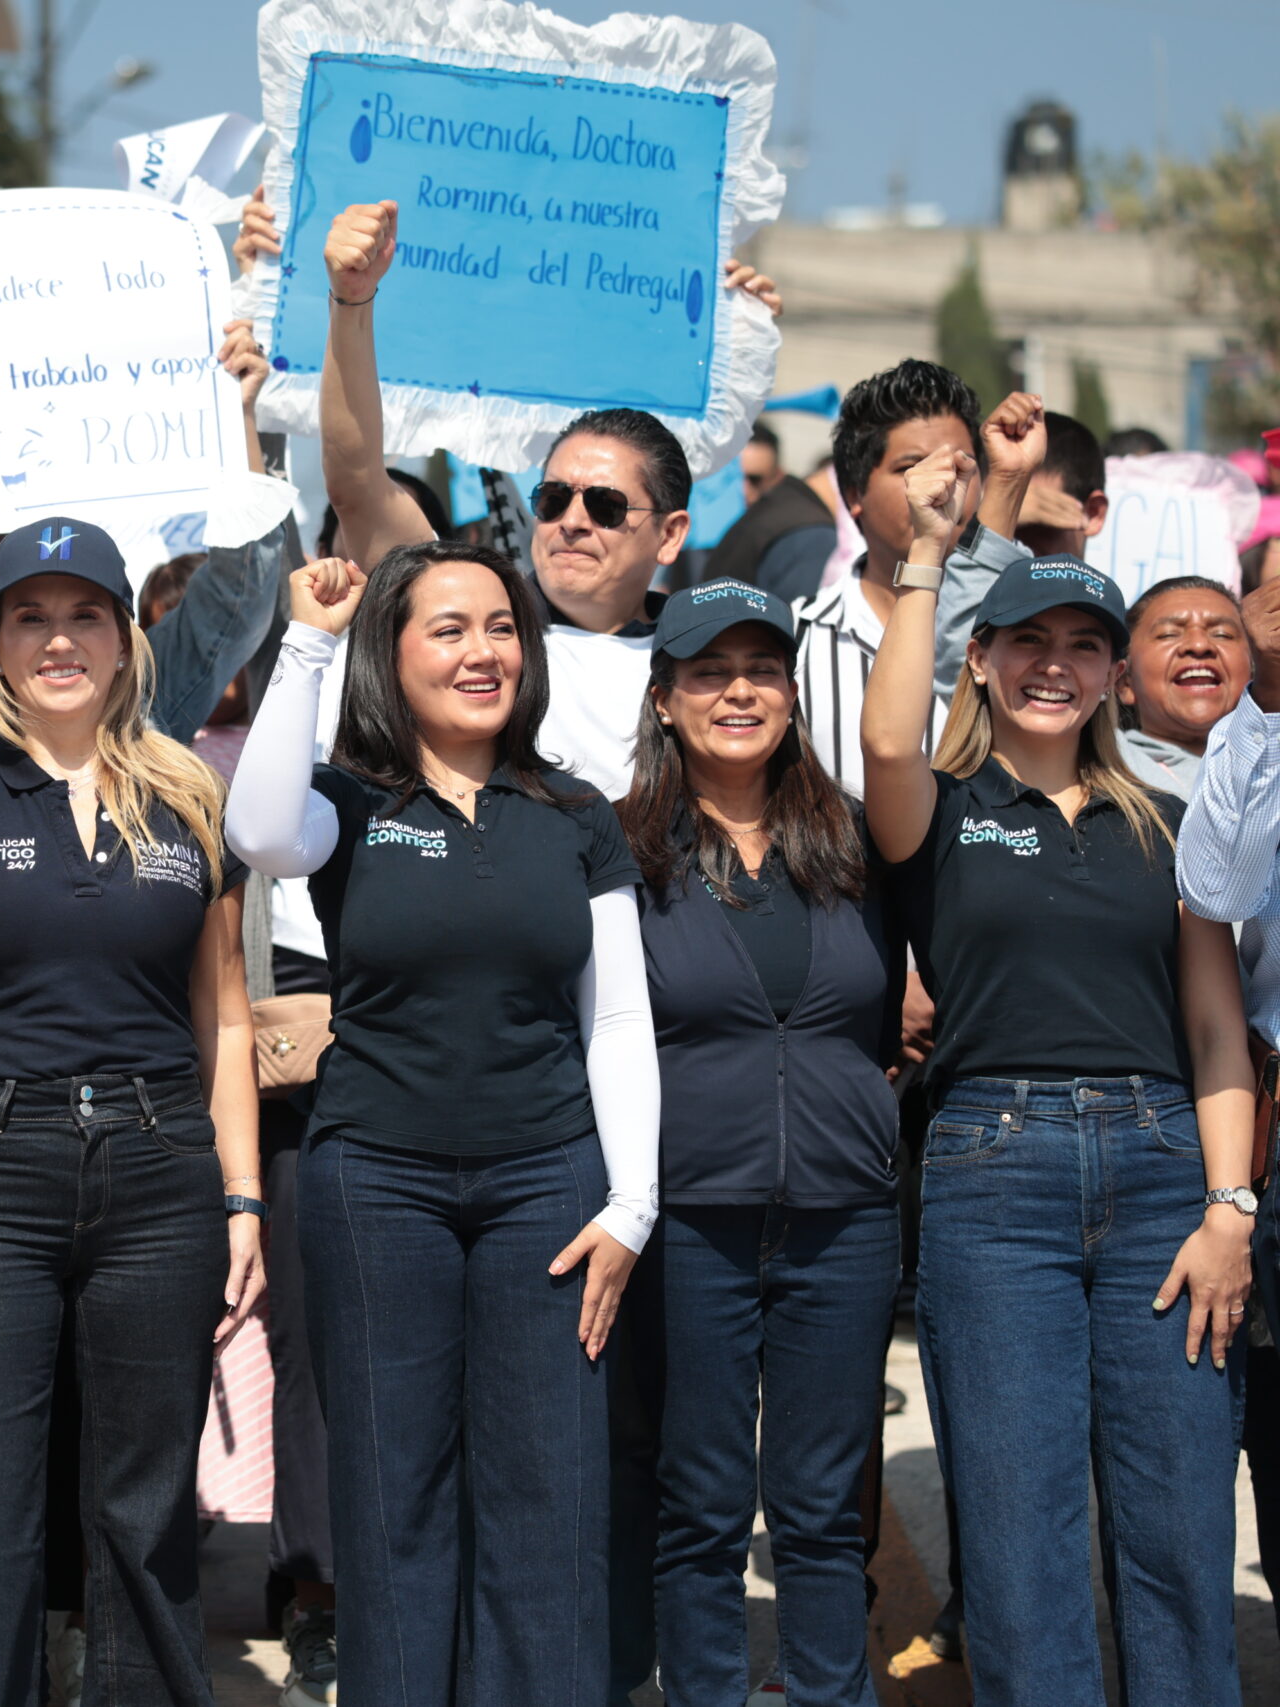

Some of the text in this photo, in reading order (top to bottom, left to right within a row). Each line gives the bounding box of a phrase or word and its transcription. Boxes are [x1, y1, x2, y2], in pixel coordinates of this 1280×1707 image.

[573, 116, 676, 171] Doctora
[417, 175, 659, 231] Romina, a nuestra
[528, 250, 569, 286] del
[127, 361, 141, 386] y
[1031, 569, 1104, 591] CONTIGO
[692, 588, 766, 605] CONTIGO
[1085, 584, 1104, 600] 24/7
[366, 829, 447, 849] CONTIGO
[960, 828, 1039, 848] CONTIGO
[420, 849, 449, 858] 24/7
[1013, 847, 1042, 856] 24/7
[6, 860, 36, 870] 24/7
